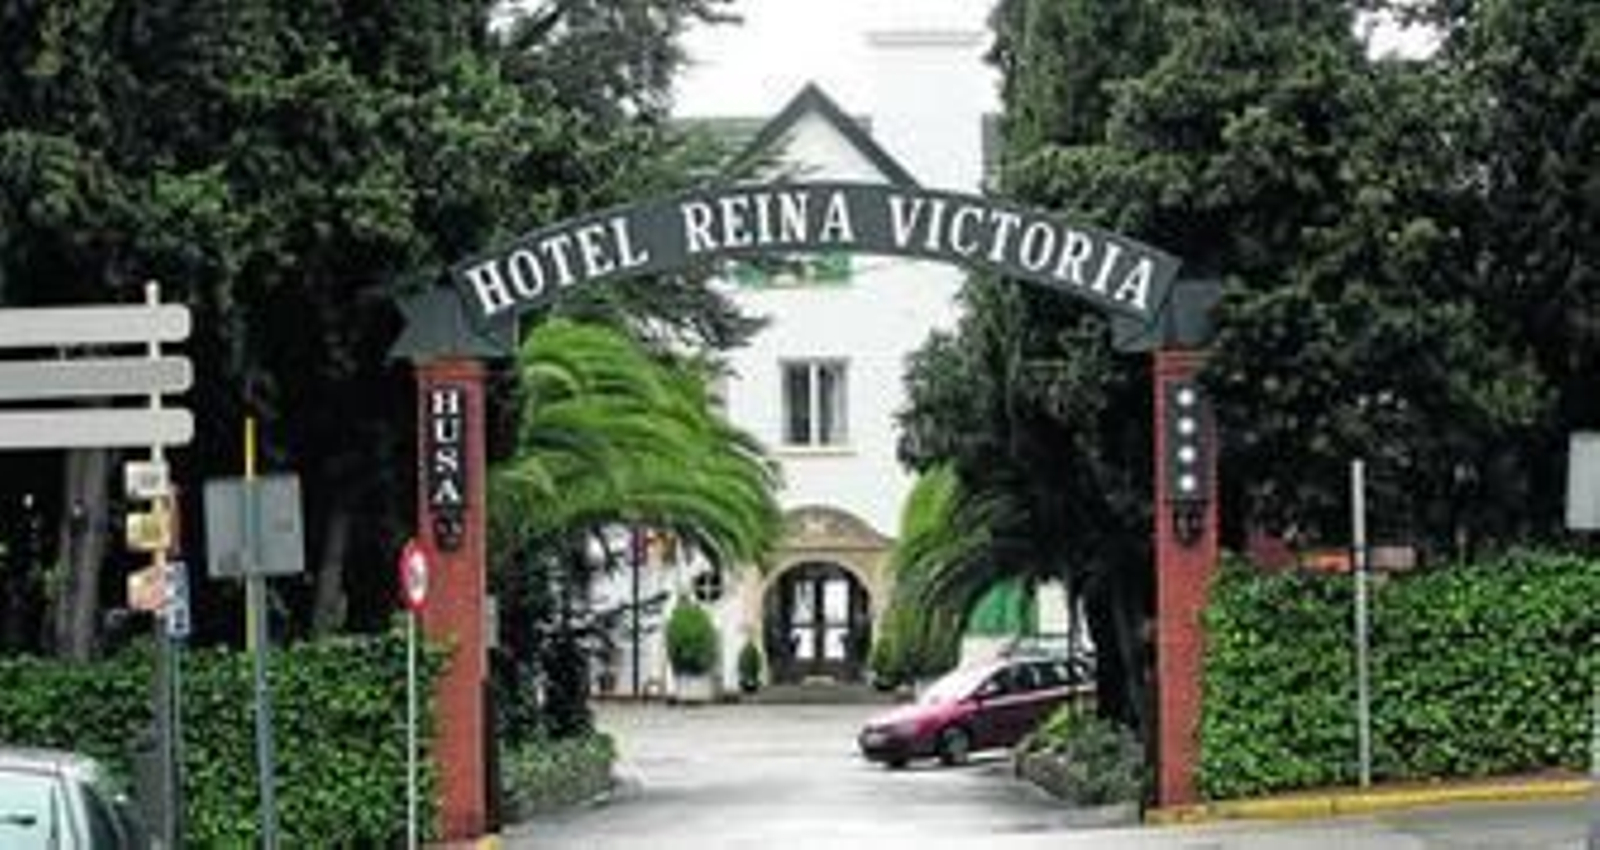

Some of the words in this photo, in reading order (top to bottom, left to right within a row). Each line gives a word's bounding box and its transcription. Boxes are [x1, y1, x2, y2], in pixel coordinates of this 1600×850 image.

[466, 216, 649, 314] HOTEL
[681, 189, 854, 252] REINA
[888, 196, 1156, 309] VICTORIA
[432, 388, 461, 503] HUSA
